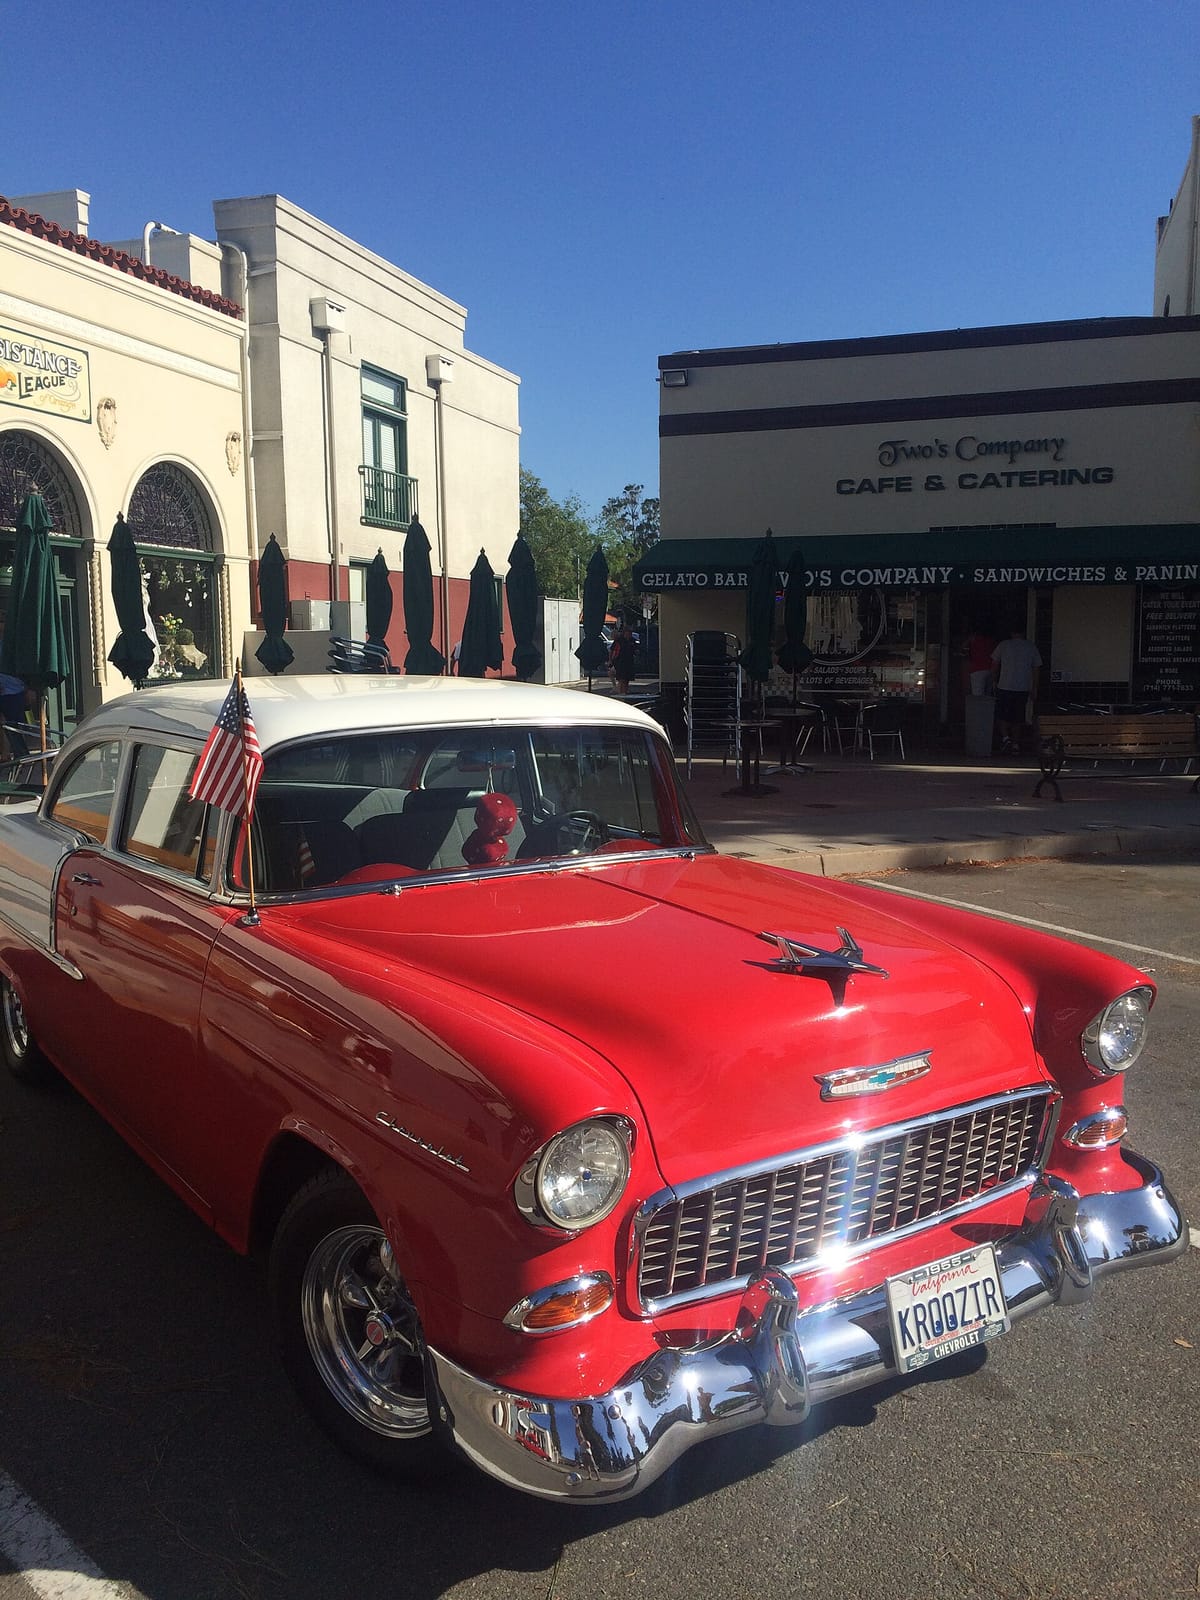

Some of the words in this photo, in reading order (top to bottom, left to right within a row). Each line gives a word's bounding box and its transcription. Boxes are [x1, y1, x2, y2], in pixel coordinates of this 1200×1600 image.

[17, 372, 66, 399] LEAGUE
[878, 439, 948, 467] Two's
[955, 436, 1065, 464] Company
[835, 476, 913, 495] CAFE
[924, 475, 946, 491] &
[958, 467, 1114, 490] CATERING
[641, 572, 708, 587] GELATO
[714, 573, 749, 586] BAR
[840, 567, 954, 586] COMPANY
[973, 566, 1106, 583] SANDWICHES
[1114, 566, 1128, 581] &
[1135, 564, 1200, 581] PANIN
[813, 666, 839, 674] SALADS
[912, 1264, 978, 1297] California
[934, 1331, 980, 1359] CHEVROLET
